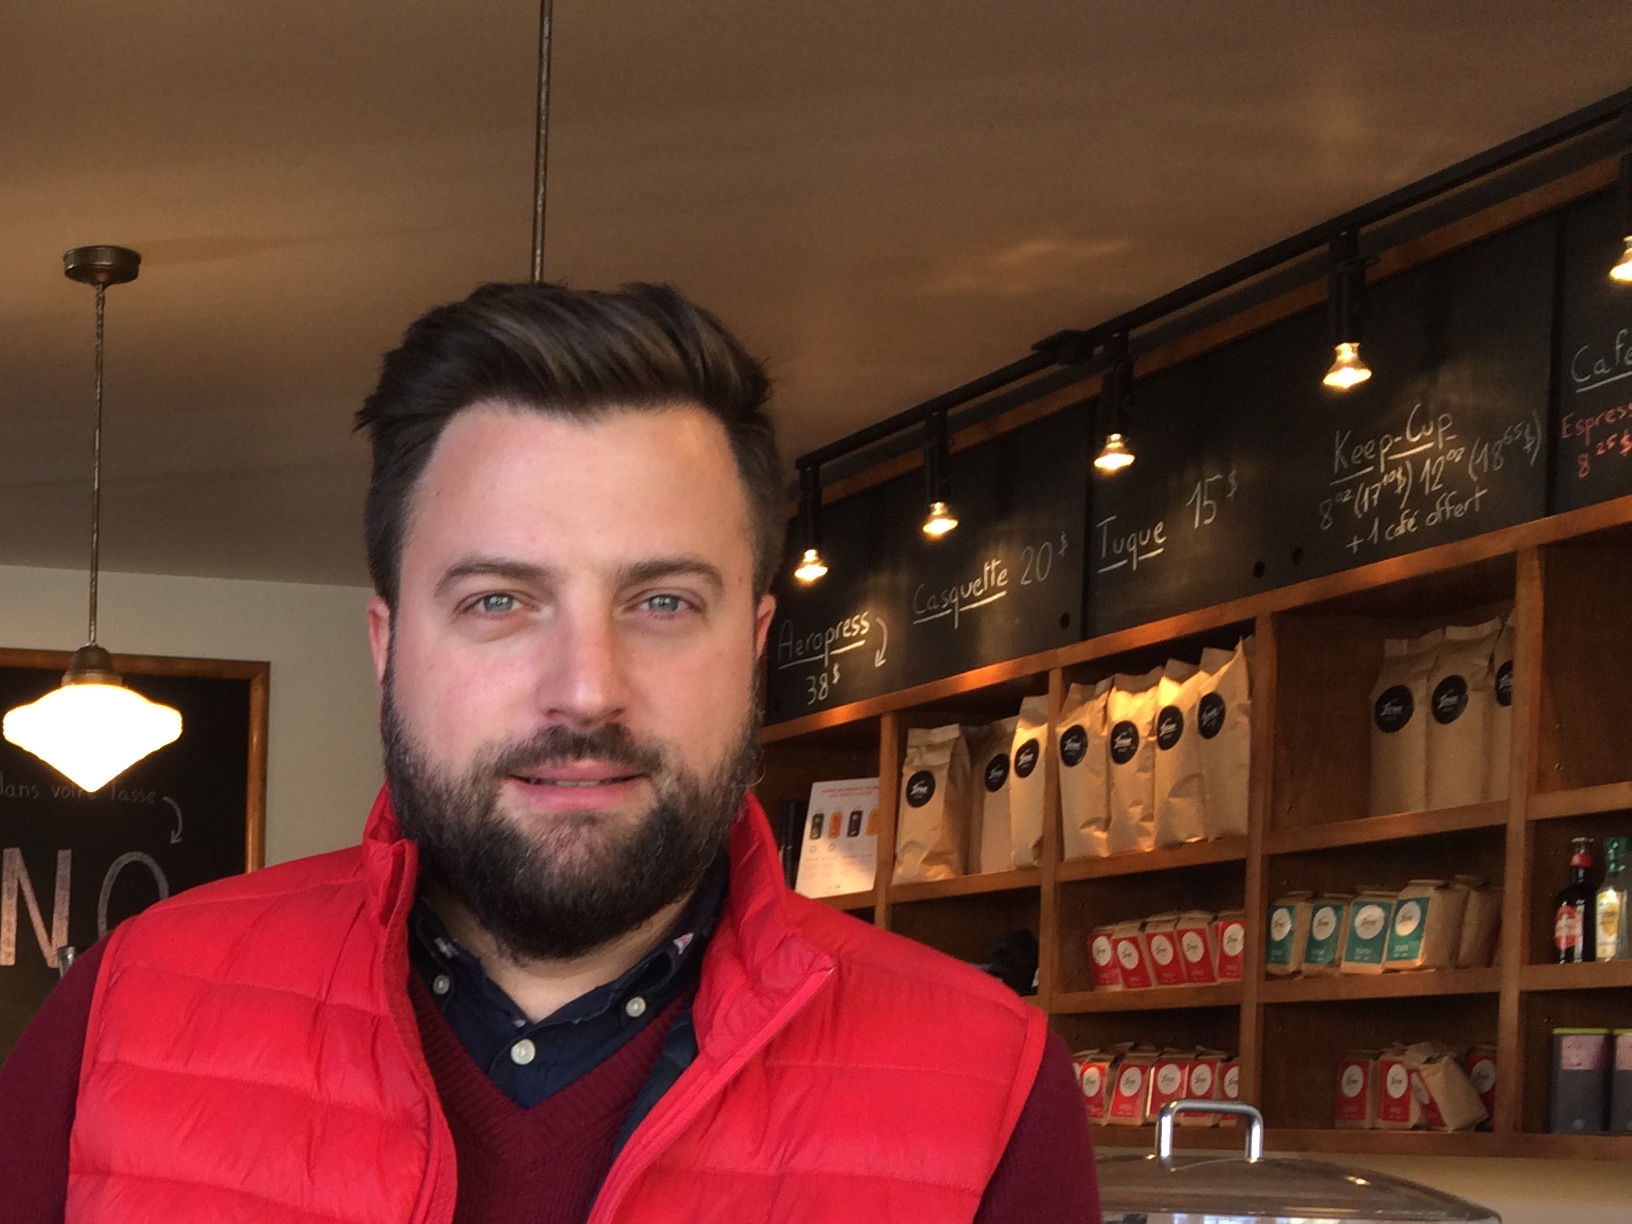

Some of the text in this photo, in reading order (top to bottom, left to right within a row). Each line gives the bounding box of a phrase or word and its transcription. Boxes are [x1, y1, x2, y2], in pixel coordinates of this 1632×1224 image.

[1334, 404, 1453, 474] Keep-Cup
[1385, 509, 1419, 541] café
[1426, 487, 1488, 527] offert
[1096, 515, 1167, 571] Tuque
[913, 559, 1009, 630] Casquette
[778, 611, 870, 667] Aeropress
